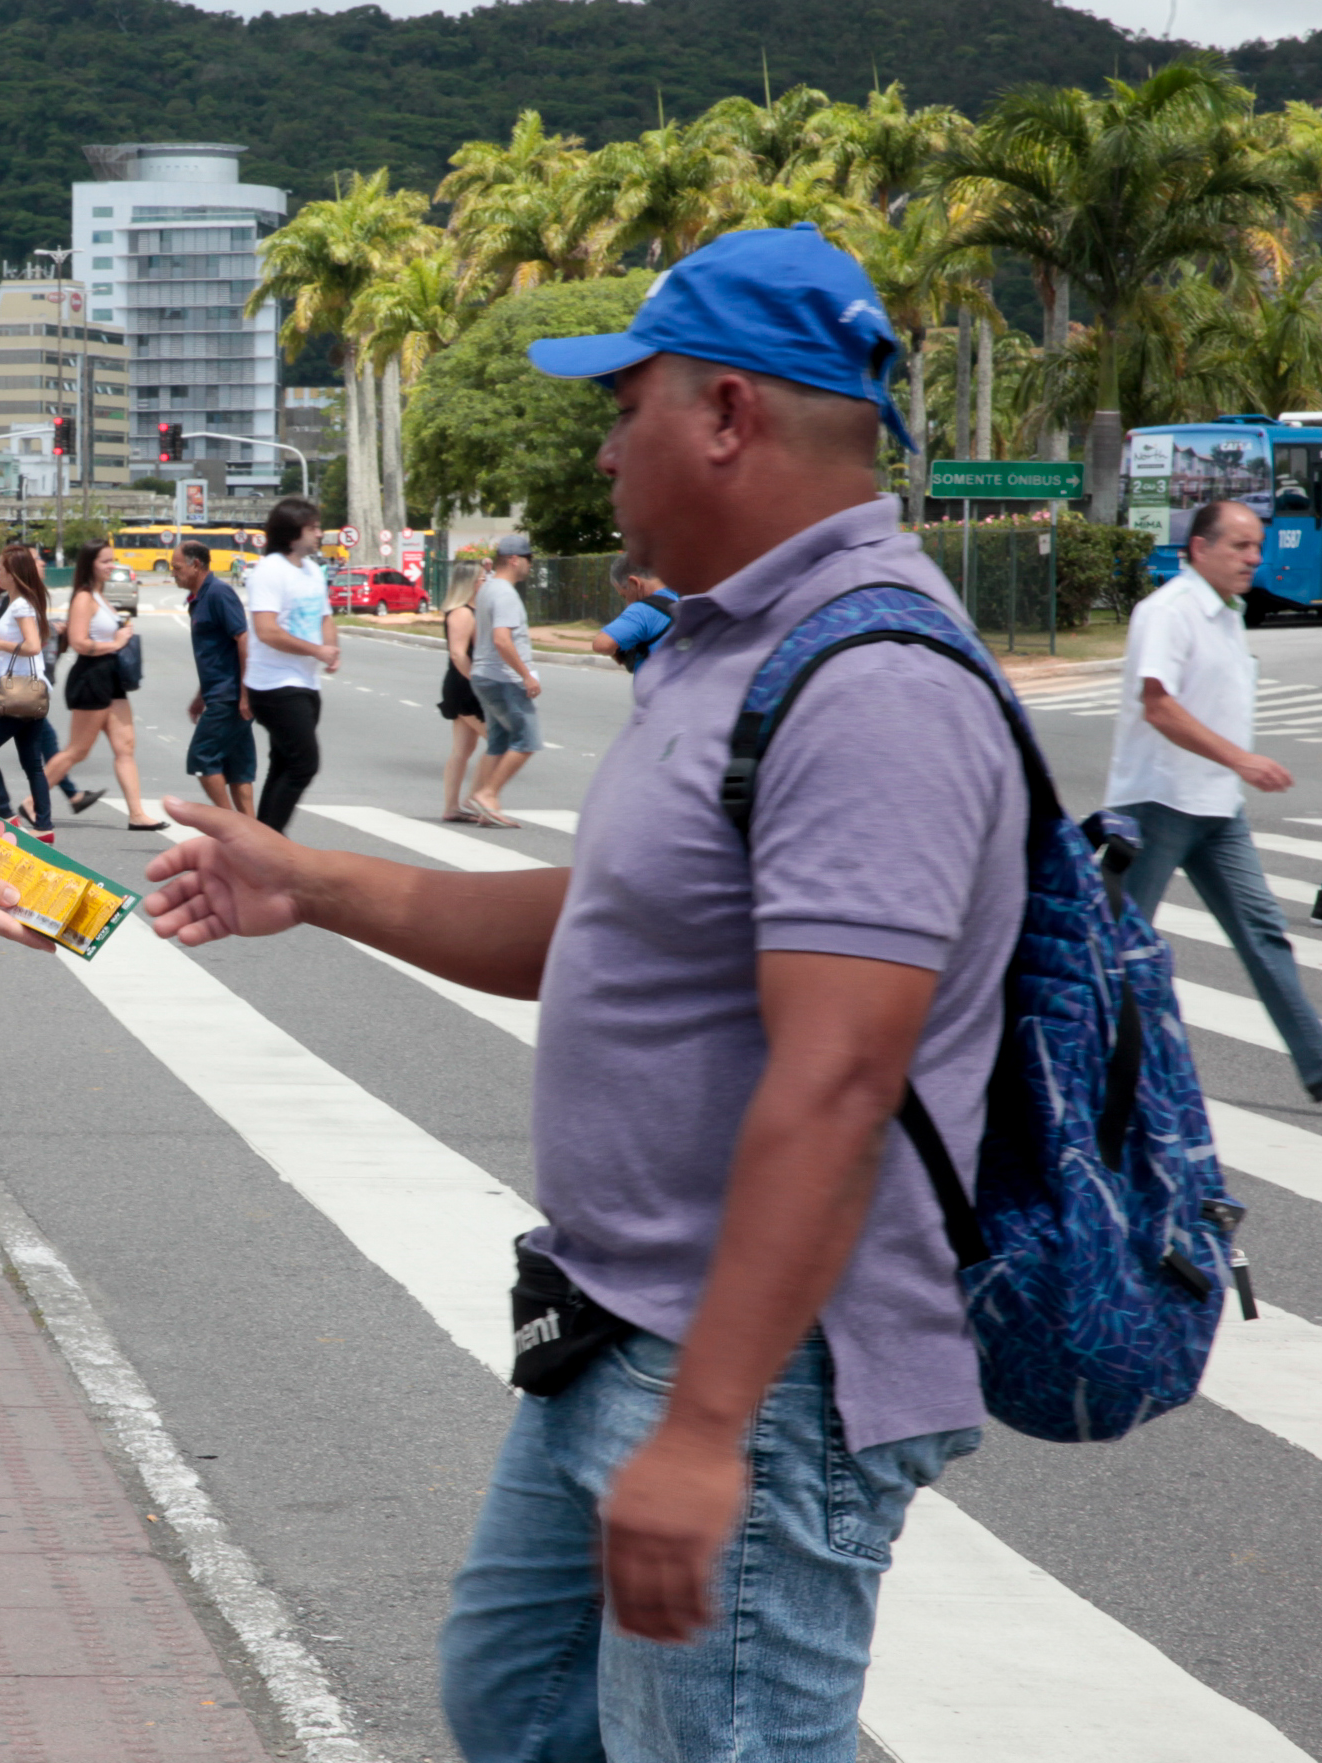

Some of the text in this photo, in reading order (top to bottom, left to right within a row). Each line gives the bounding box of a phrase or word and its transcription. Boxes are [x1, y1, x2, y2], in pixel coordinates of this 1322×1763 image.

[932, 473, 1003, 486] SOMENTE
[1132, 480, 1142, 494] 2
[1156, 479, 1166, 493] 3
